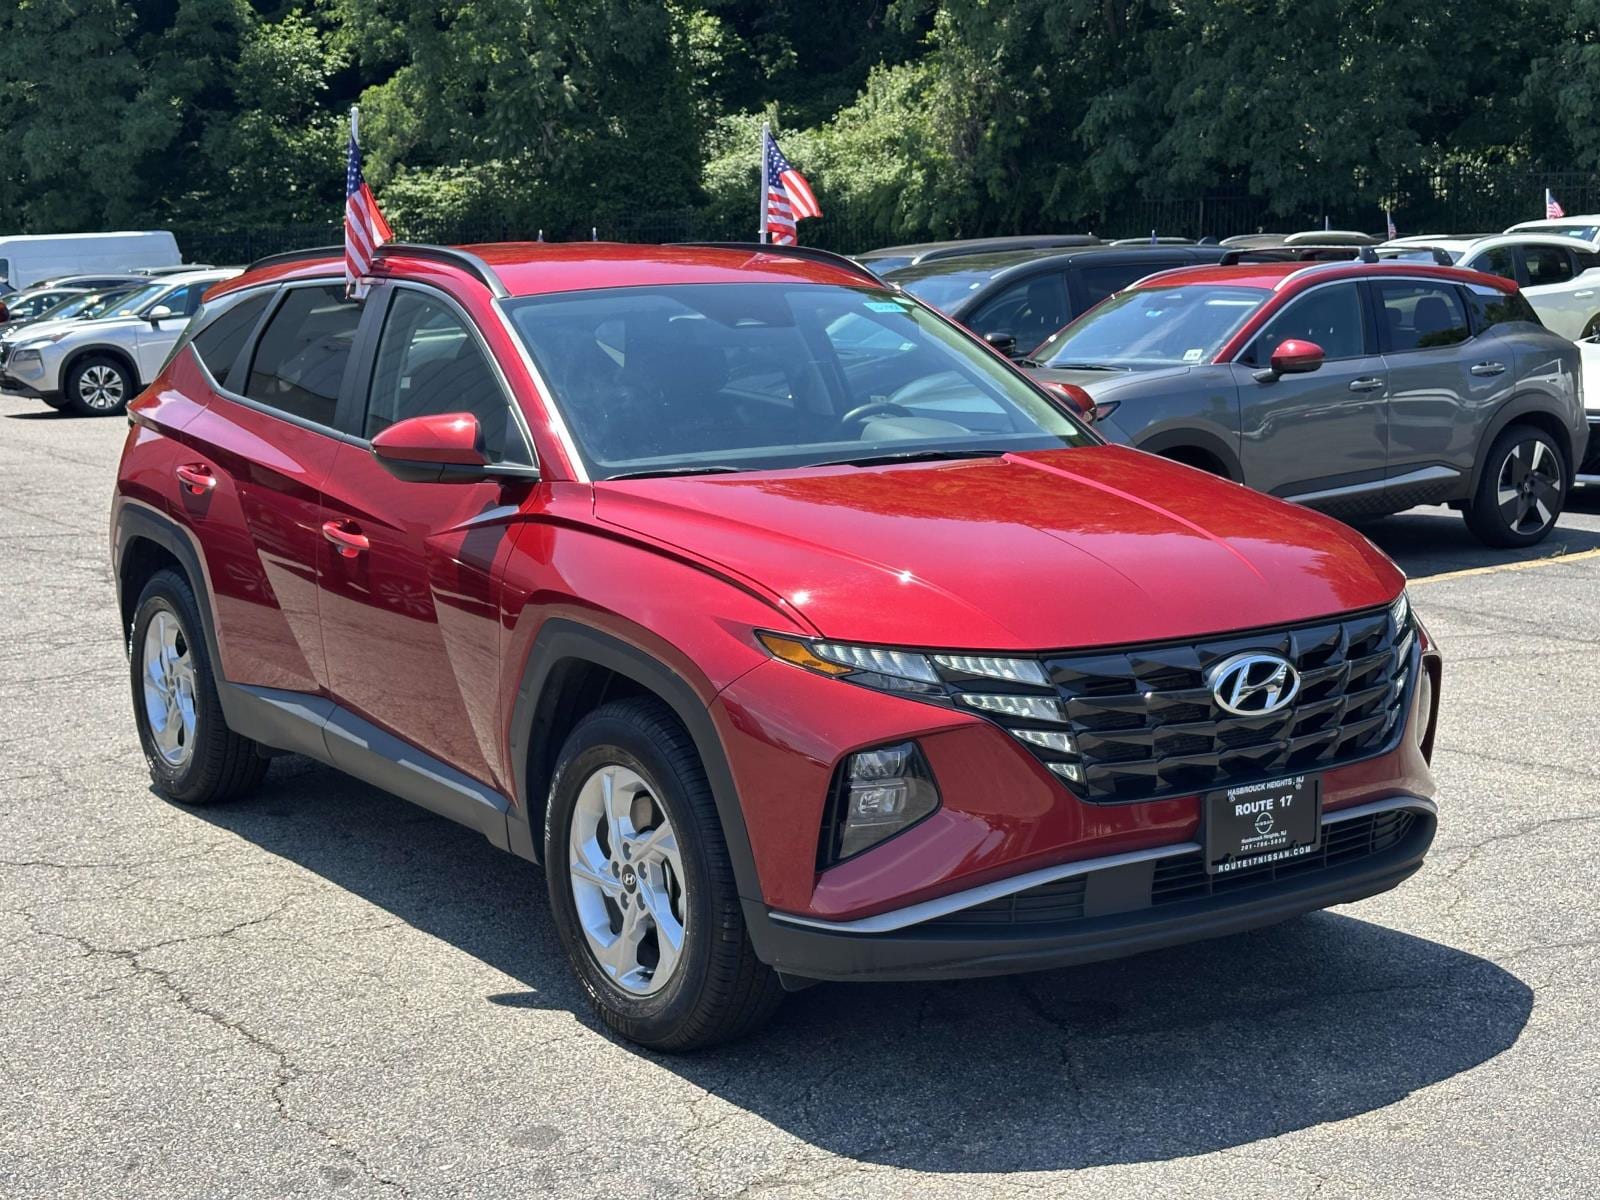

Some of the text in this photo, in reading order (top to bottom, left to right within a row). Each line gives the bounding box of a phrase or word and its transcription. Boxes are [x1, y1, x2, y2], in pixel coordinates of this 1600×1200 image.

[1227, 782, 1266, 797] HASBROUCK
[1235, 795, 1293, 816] ROUTE 17
[1218, 846, 1311, 872] ROUTE17NISSAN.COM
